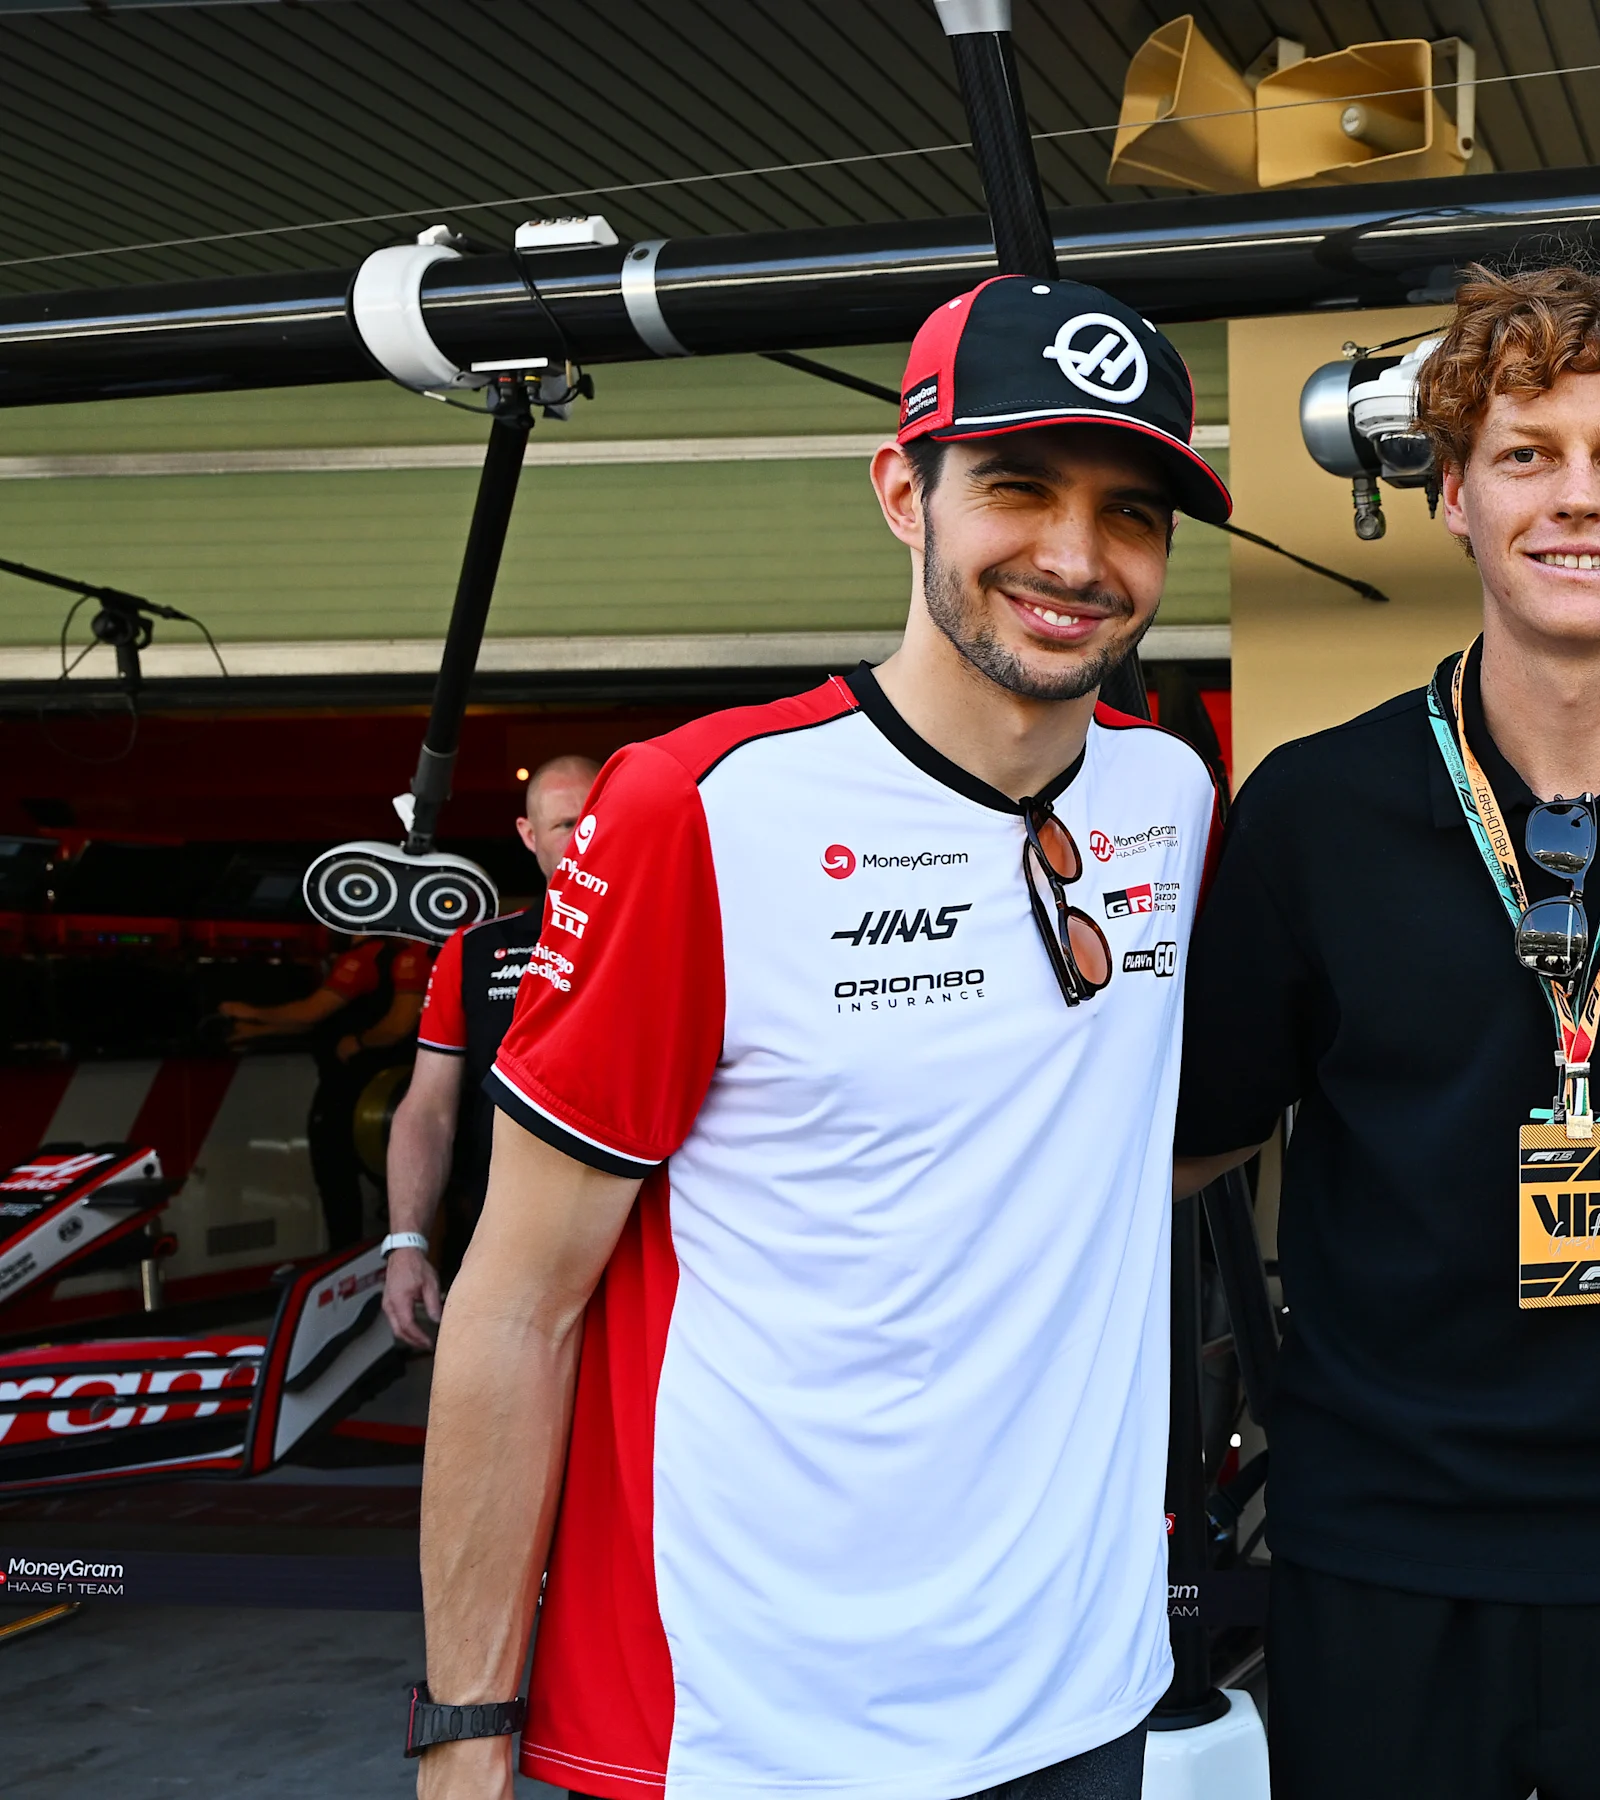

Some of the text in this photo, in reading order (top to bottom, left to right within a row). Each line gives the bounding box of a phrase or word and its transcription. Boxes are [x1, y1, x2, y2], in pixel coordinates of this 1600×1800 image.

[1113, 825, 1176, 847] MoneyGram
[862, 852, 968, 870] MoneyGram
[1116, 847, 1147, 859] HAAS
[1154, 882, 1180, 891] TOYOTA
[830, 903, 973, 946] HAAS
[1125, 944, 1177, 975] PLAY'n GO
[834, 969, 984, 998] ORION180
[838, 989, 984, 1013] INSURANCE
[8, 1558, 124, 1580] MoneyGram
[7, 1581, 124, 1595] HAAS F1 TEAM
